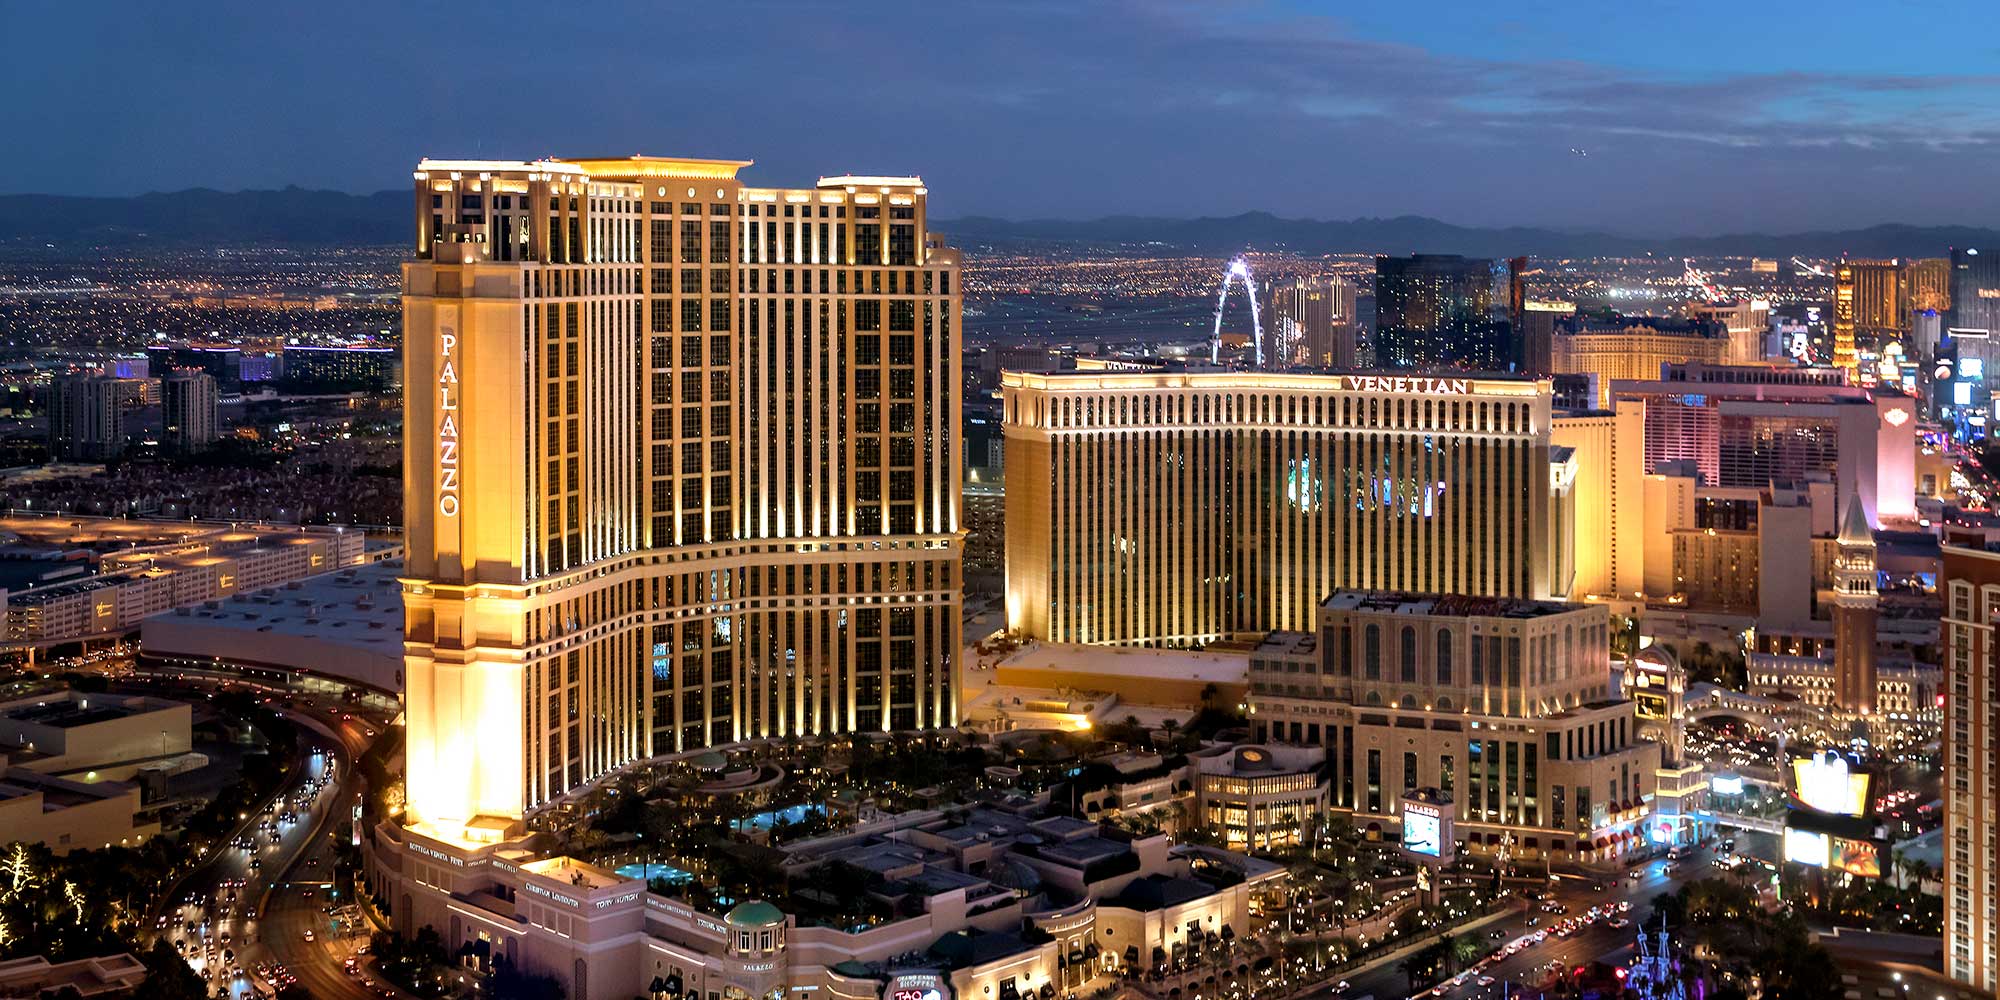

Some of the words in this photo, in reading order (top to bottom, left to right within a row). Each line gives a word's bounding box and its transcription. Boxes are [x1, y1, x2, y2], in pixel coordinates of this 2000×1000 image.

[1348, 376, 1468, 395] VENETIAN
[440, 334, 459, 517] PALAZZO
[1404, 803, 1440, 817] PALAZZO
[743, 963, 774, 973] PALAZZO
[900, 980, 935, 988] SHOPPES
[895, 991, 922, 1000] TAO
